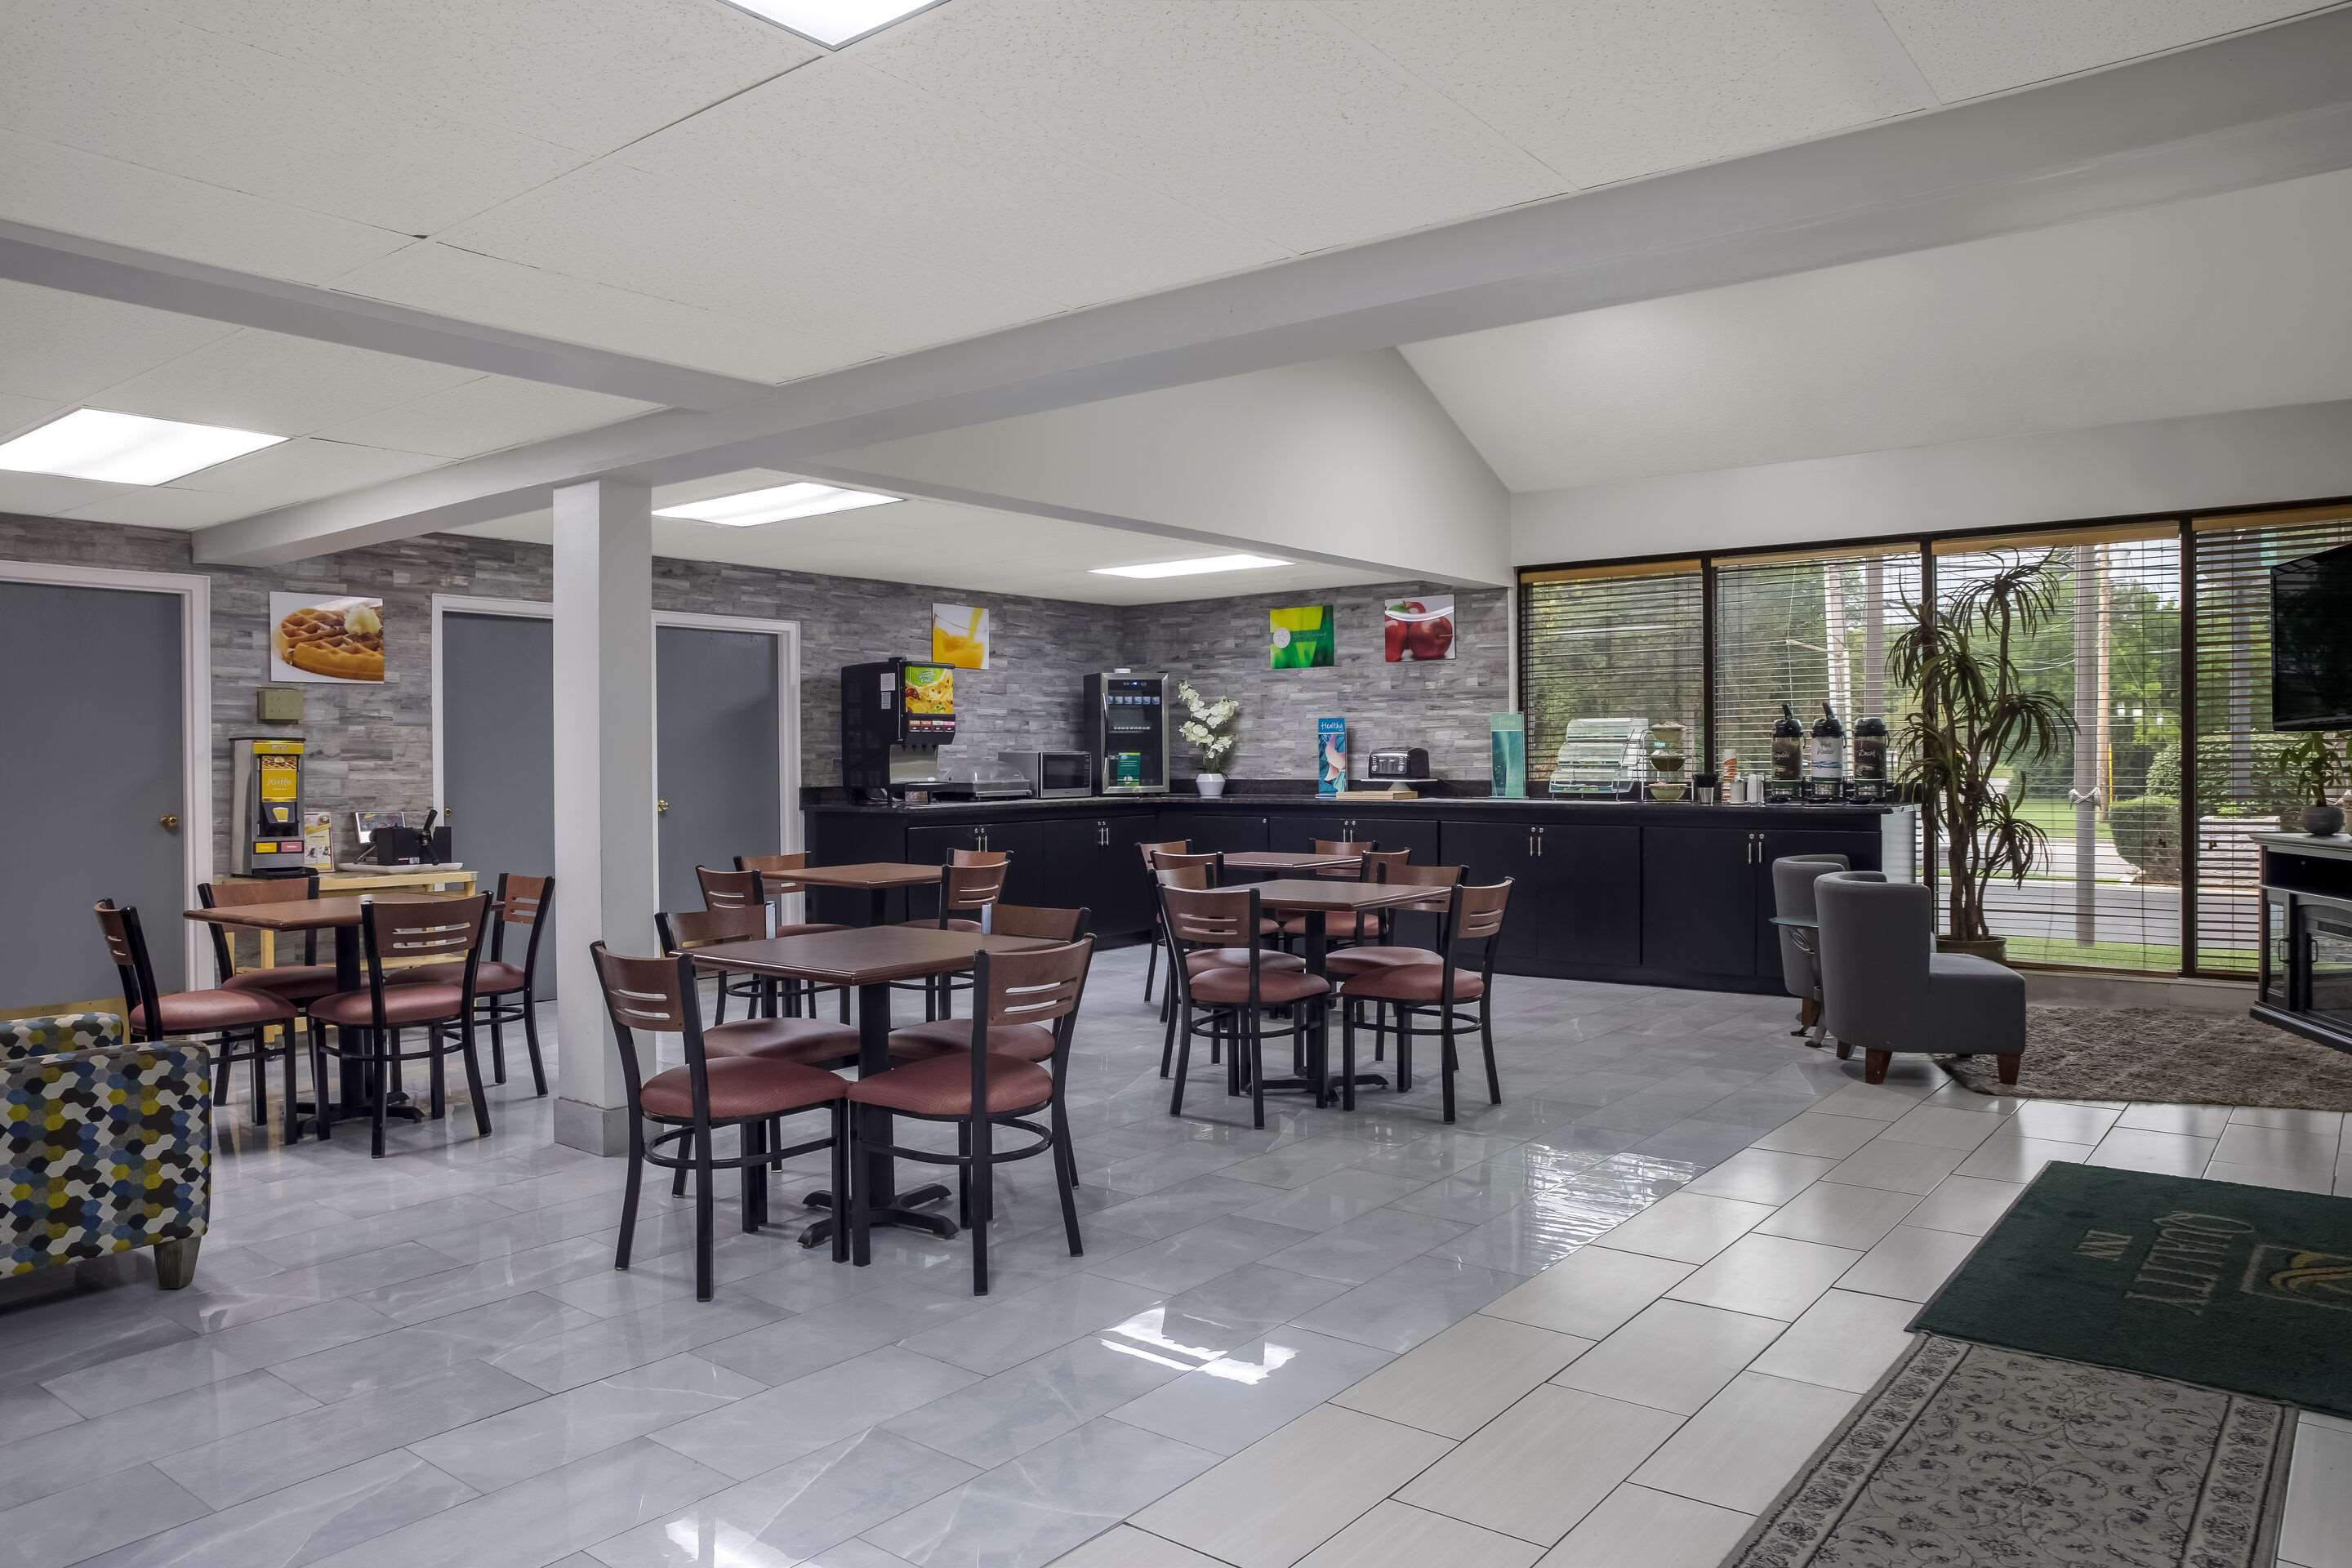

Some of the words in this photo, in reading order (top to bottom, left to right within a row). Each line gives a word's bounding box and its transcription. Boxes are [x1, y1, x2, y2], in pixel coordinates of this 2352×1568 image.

[1321, 721, 1343, 732] Healthy
[267, 777, 292, 787] Waffle
[2124, 1210, 2255, 1316] QUALITY
